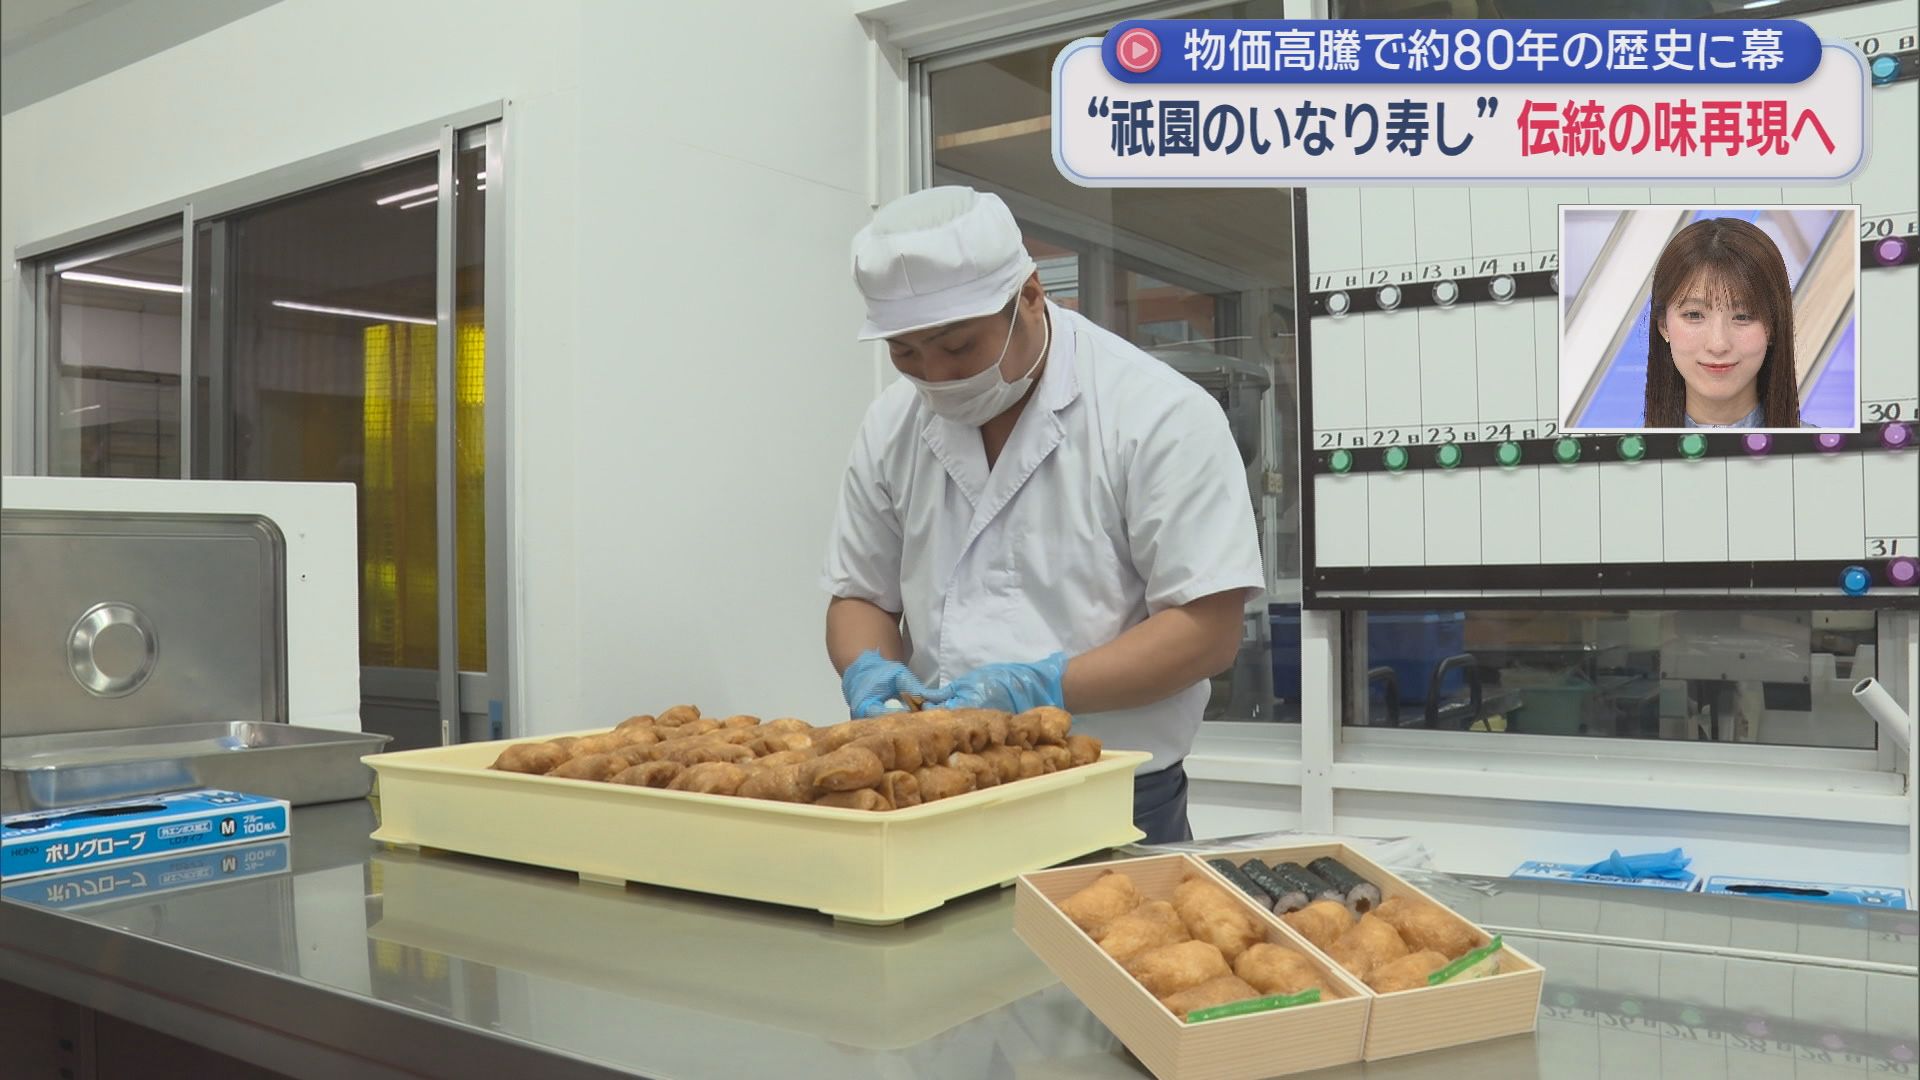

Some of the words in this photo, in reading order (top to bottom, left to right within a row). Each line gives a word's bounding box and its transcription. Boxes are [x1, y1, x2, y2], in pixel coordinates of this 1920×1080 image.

[1871, 539, 1897, 556] 31
[221, 820, 235, 834] M
[45, 831, 146, 863] ポリグローブ
